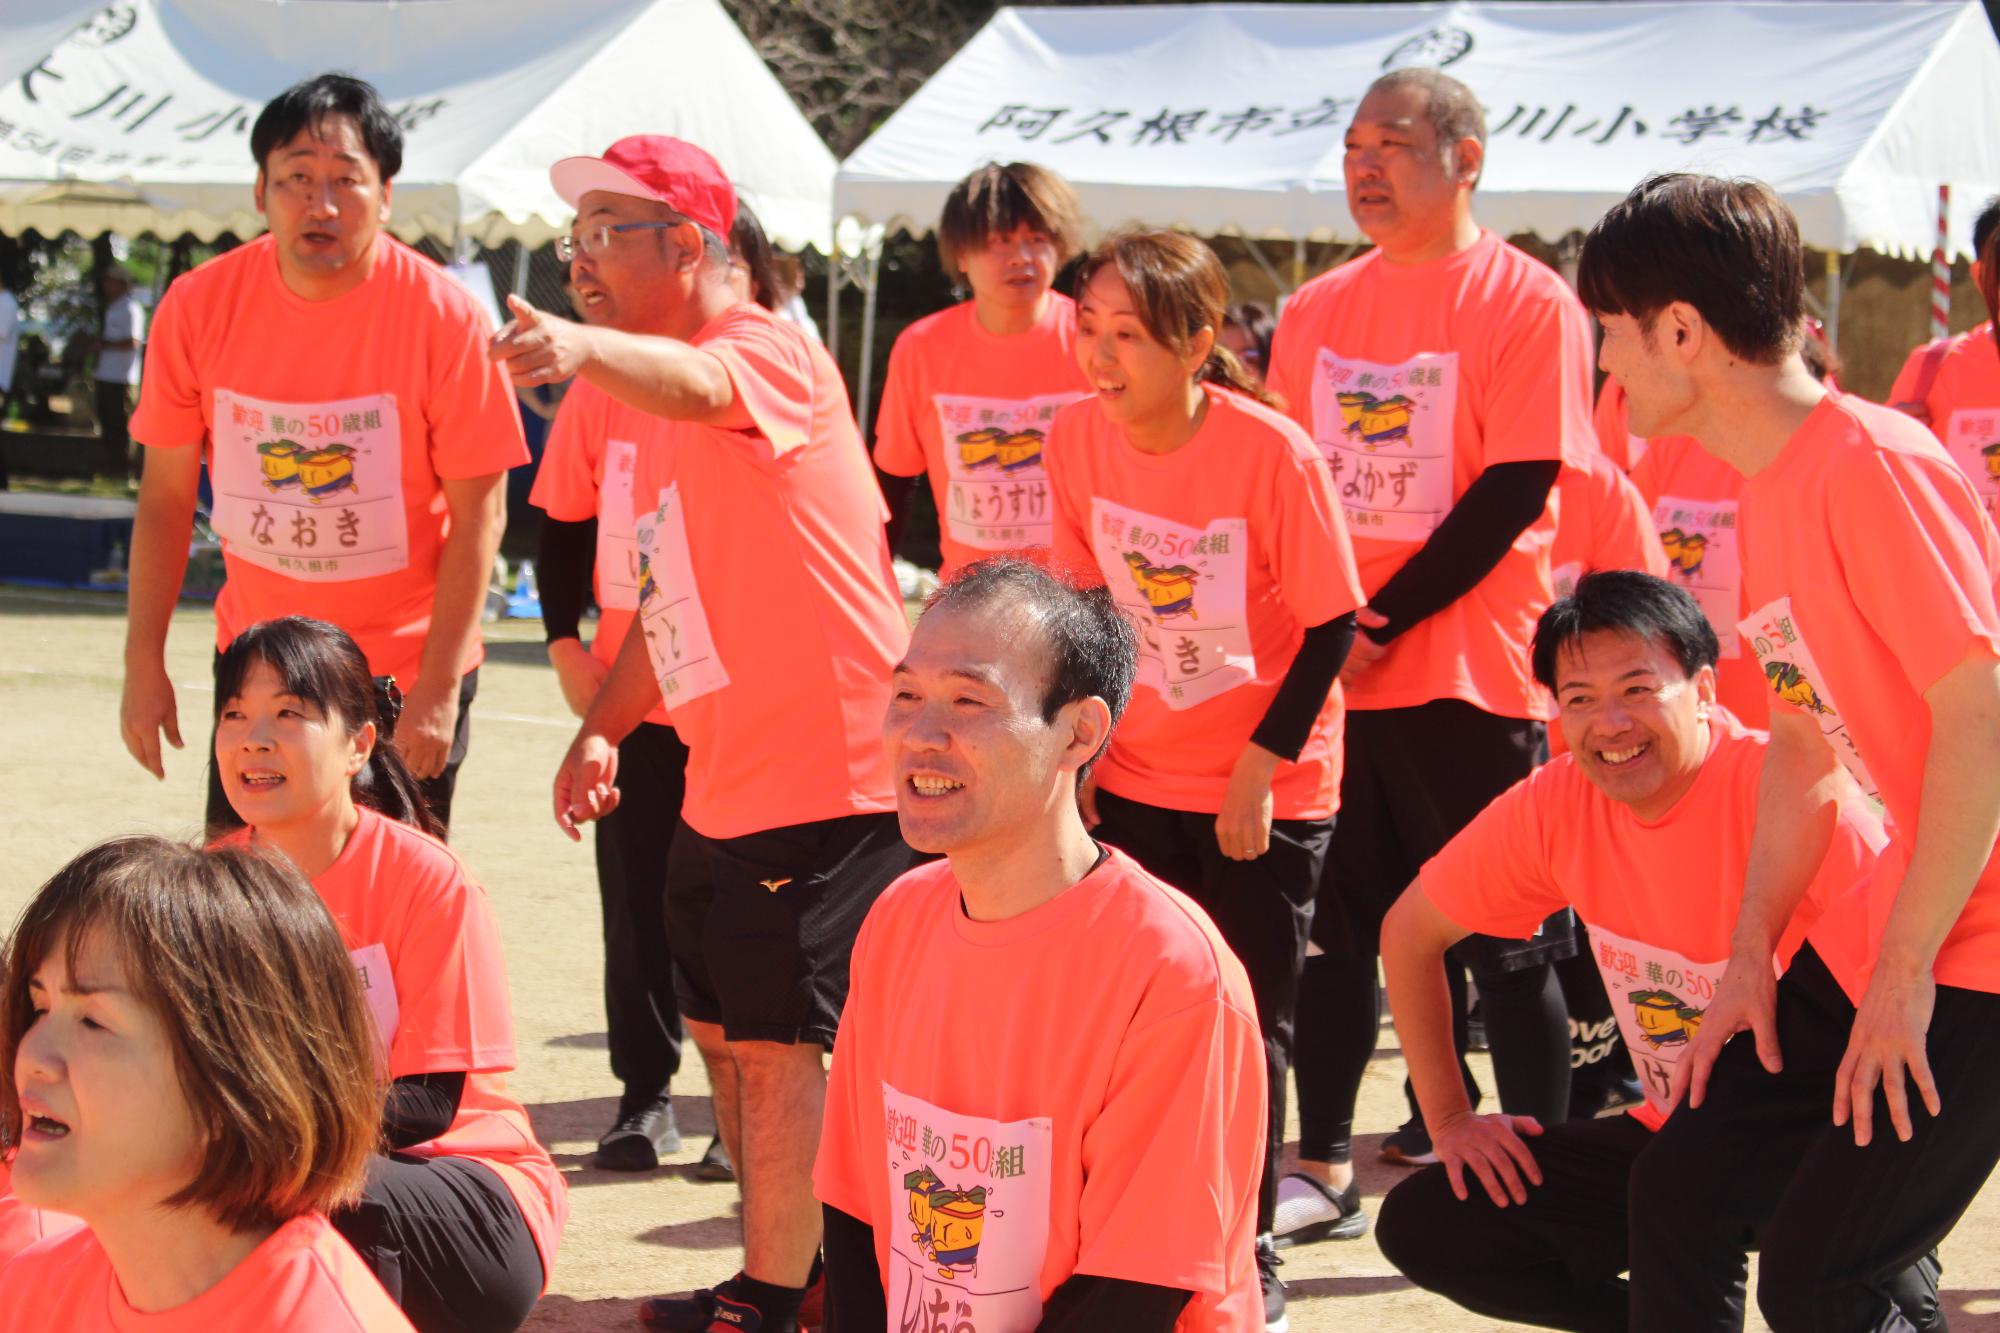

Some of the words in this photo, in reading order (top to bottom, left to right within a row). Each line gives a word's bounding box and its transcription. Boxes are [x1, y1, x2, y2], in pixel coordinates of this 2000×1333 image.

[977, 97, 1827, 145] 阿久根市立川小学校
[270, 409, 382, 438] 華の50歳組
[953, 483, 1047, 521] りょうすけ
[251, 504, 360, 548] なおき
[277, 557, 339, 573] 阿久根市
[1645, 961, 1722, 1000] 華の50
